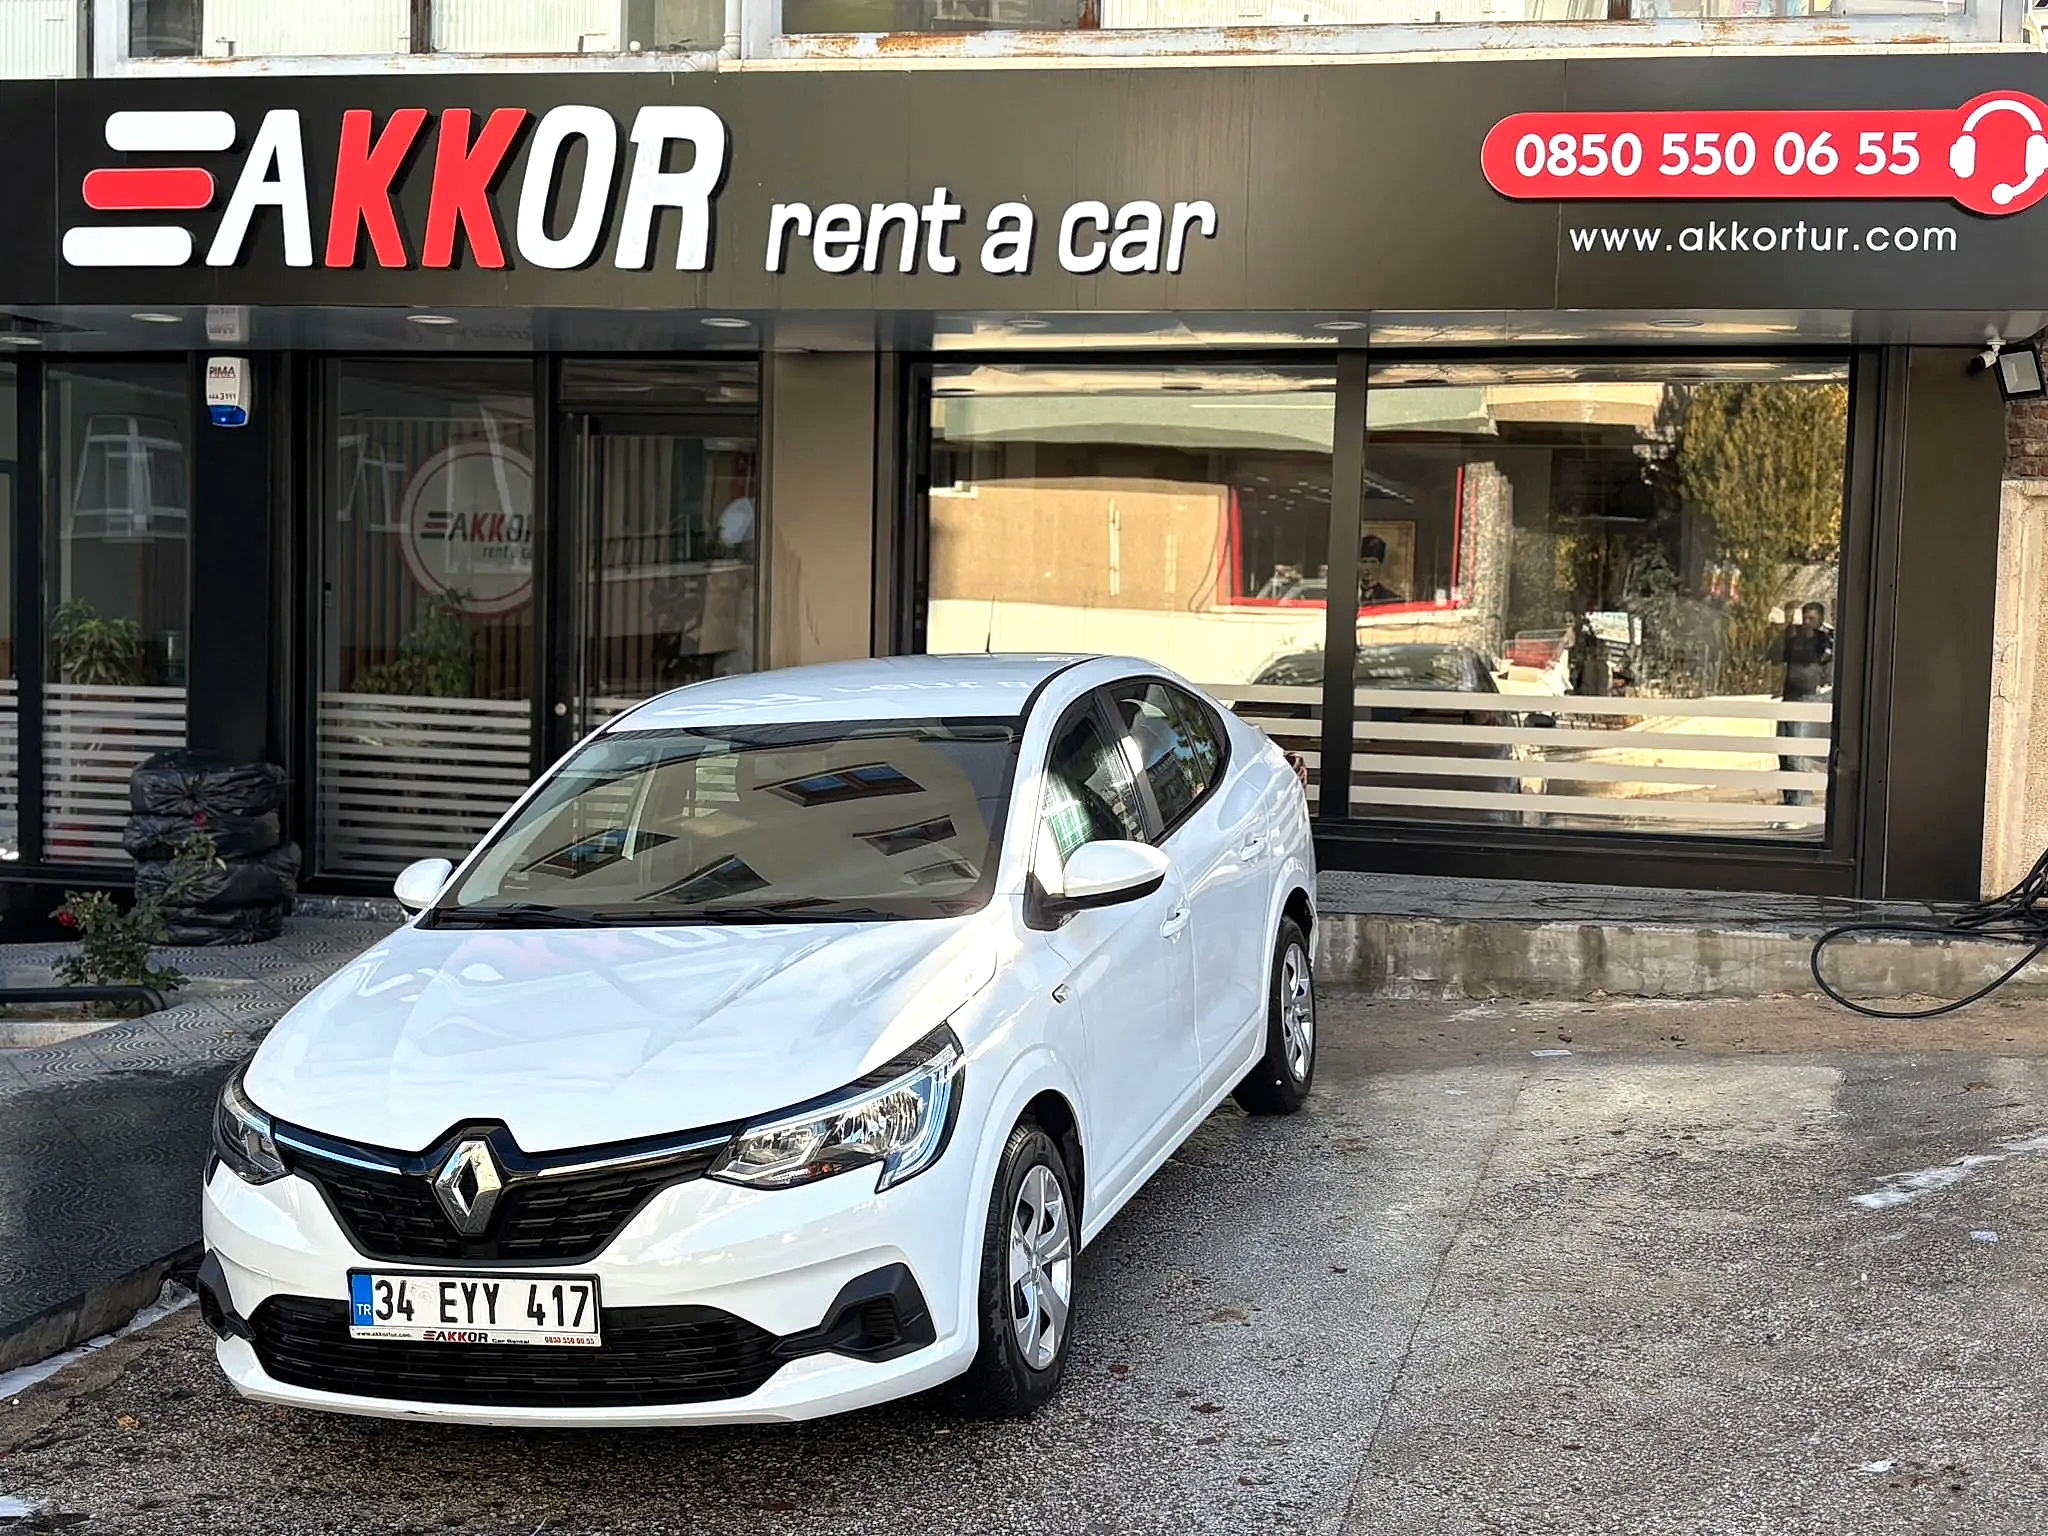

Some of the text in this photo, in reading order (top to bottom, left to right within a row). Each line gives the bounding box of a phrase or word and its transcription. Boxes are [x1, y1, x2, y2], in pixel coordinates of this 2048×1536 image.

[1514, 130, 1920, 178] 0850 550 06 55
[205, 105, 726, 270] AKKOR
[765, 186, 1217, 274] rent a car
[1569, 220, 1957, 252] www.akkortur.com
[356, 1303, 372, 1316] TR
[374, 1279, 589, 1328] 34 EYY 417
[435, 1331, 489, 1343] AKKOR
